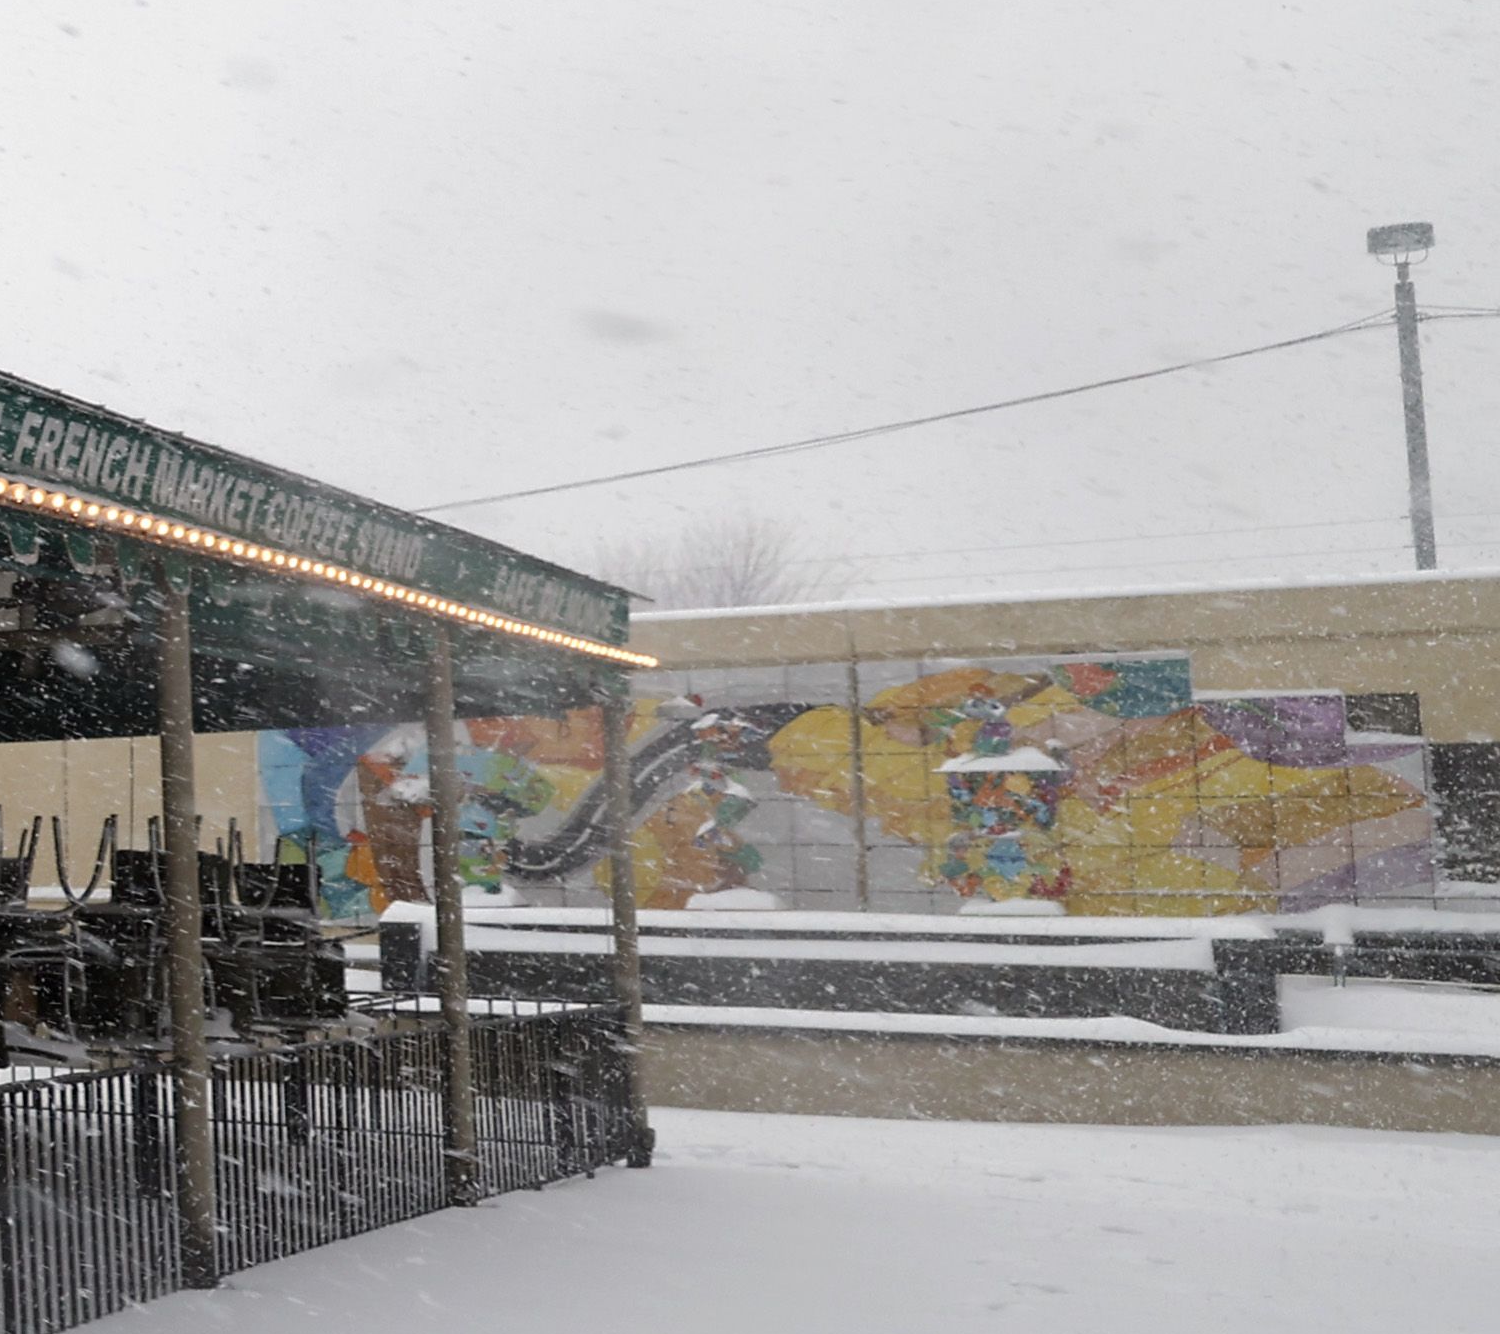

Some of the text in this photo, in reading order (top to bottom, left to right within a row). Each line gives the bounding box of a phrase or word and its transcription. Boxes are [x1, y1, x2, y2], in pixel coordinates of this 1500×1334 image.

[13, 411, 149, 501] FRENCH
[152, 449, 266, 533] MARKET
[264, 491, 355, 560] COFFEE
[353, 519, 424, 580] STAND
